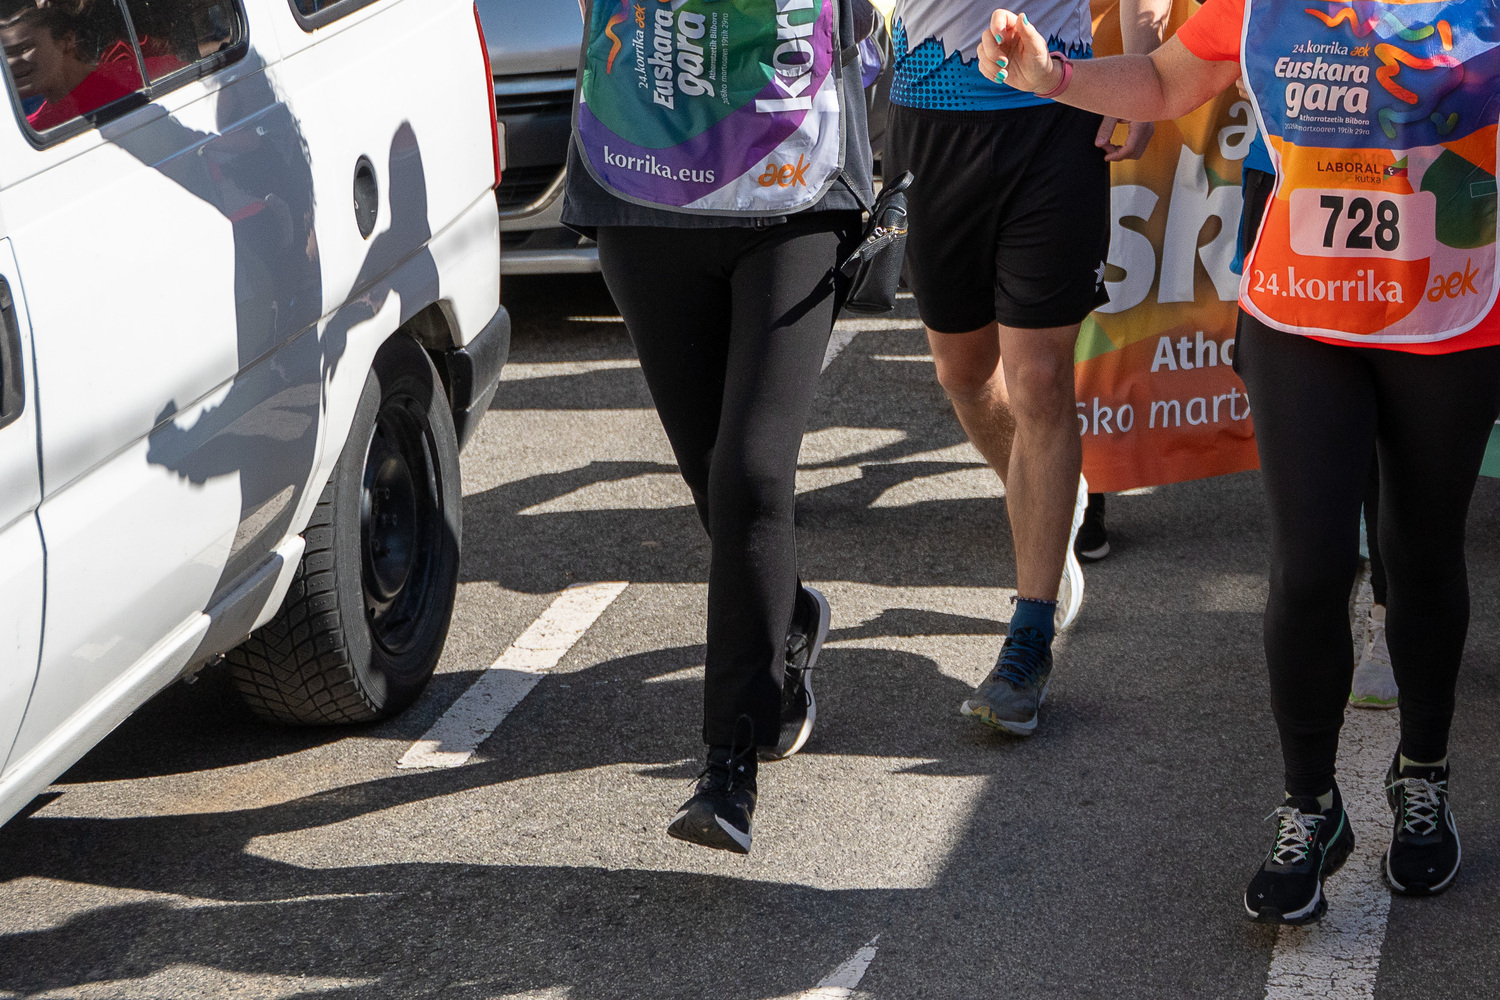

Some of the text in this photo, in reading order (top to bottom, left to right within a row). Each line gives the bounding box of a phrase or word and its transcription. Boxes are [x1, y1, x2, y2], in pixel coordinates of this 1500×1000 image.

[631, 30, 649, 89] 24.korrika
[647, 8, 675, 110] Euskara
[676, 10, 715, 98] gara
[1292, 40, 1371, 57] 24.korrika aek
[1274, 56, 1370, 83] Euskara
[1285, 81, 1369, 118] gara
[1337, 126, 1353, 135] 19tik
[1345, 117, 1370, 125] Bilbora
[604, 145, 716, 184] korrika.eus
[757, 152, 812, 188] aek
[1317, 161, 1381, 175] LABORAL
[1355, 174, 1381, 184] kutxa
[1320, 195, 1400, 252] 728
[1253, 258, 1480, 304] 24.korrika aek
